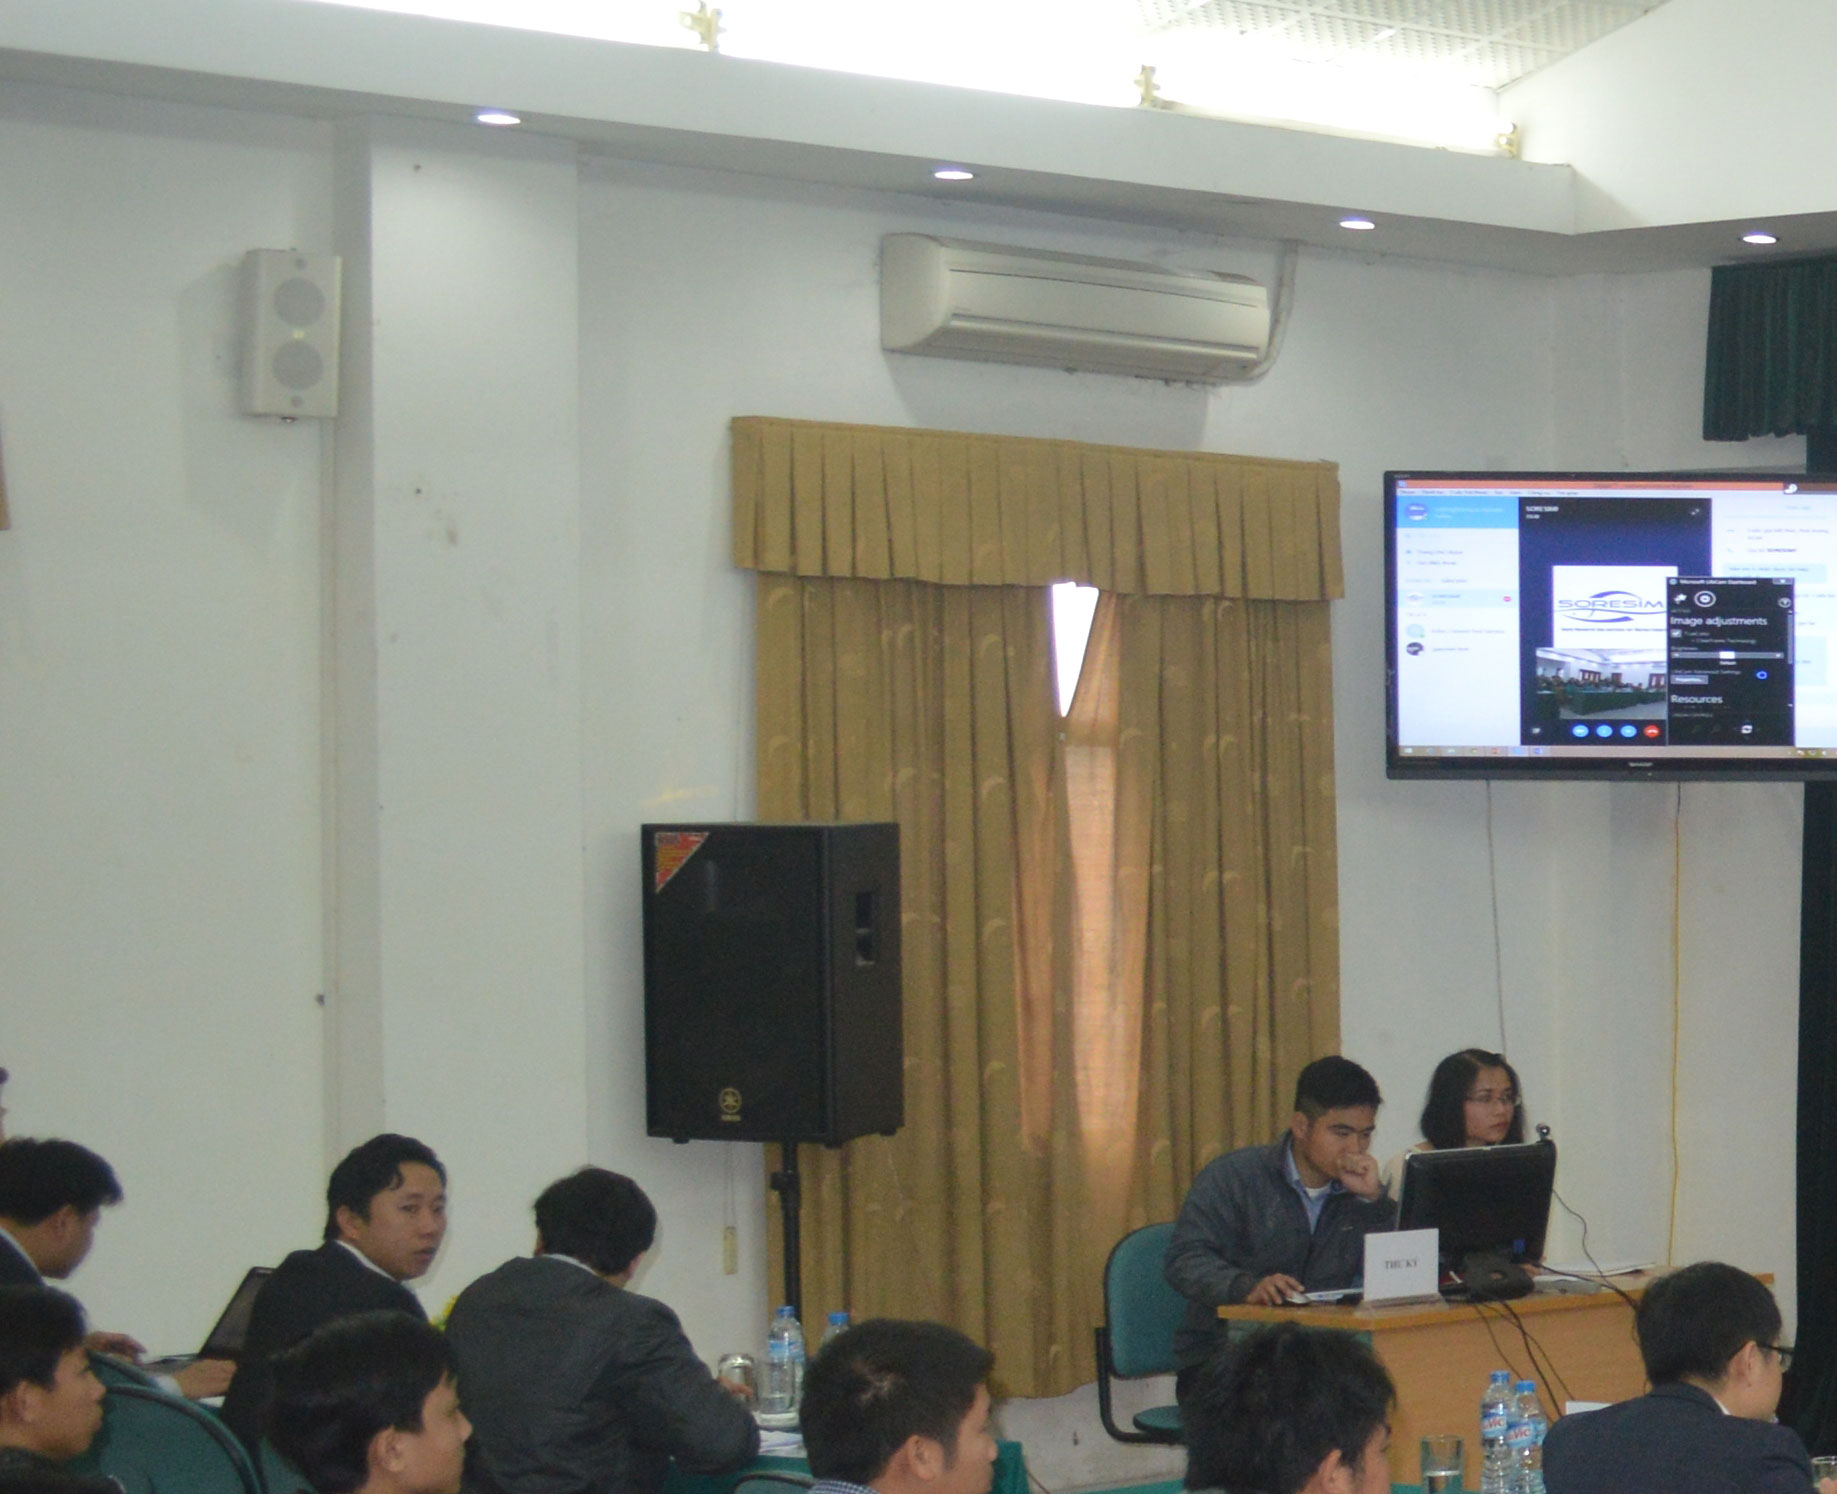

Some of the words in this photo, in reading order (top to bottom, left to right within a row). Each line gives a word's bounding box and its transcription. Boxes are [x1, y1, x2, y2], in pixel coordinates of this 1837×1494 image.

[1558, 598, 1664, 609] SORESIM
[1670, 616, 1703, 628] Image
[1705, 616, 1768, 628] adjustments
[1670, 694, 1724, 704] Resources
